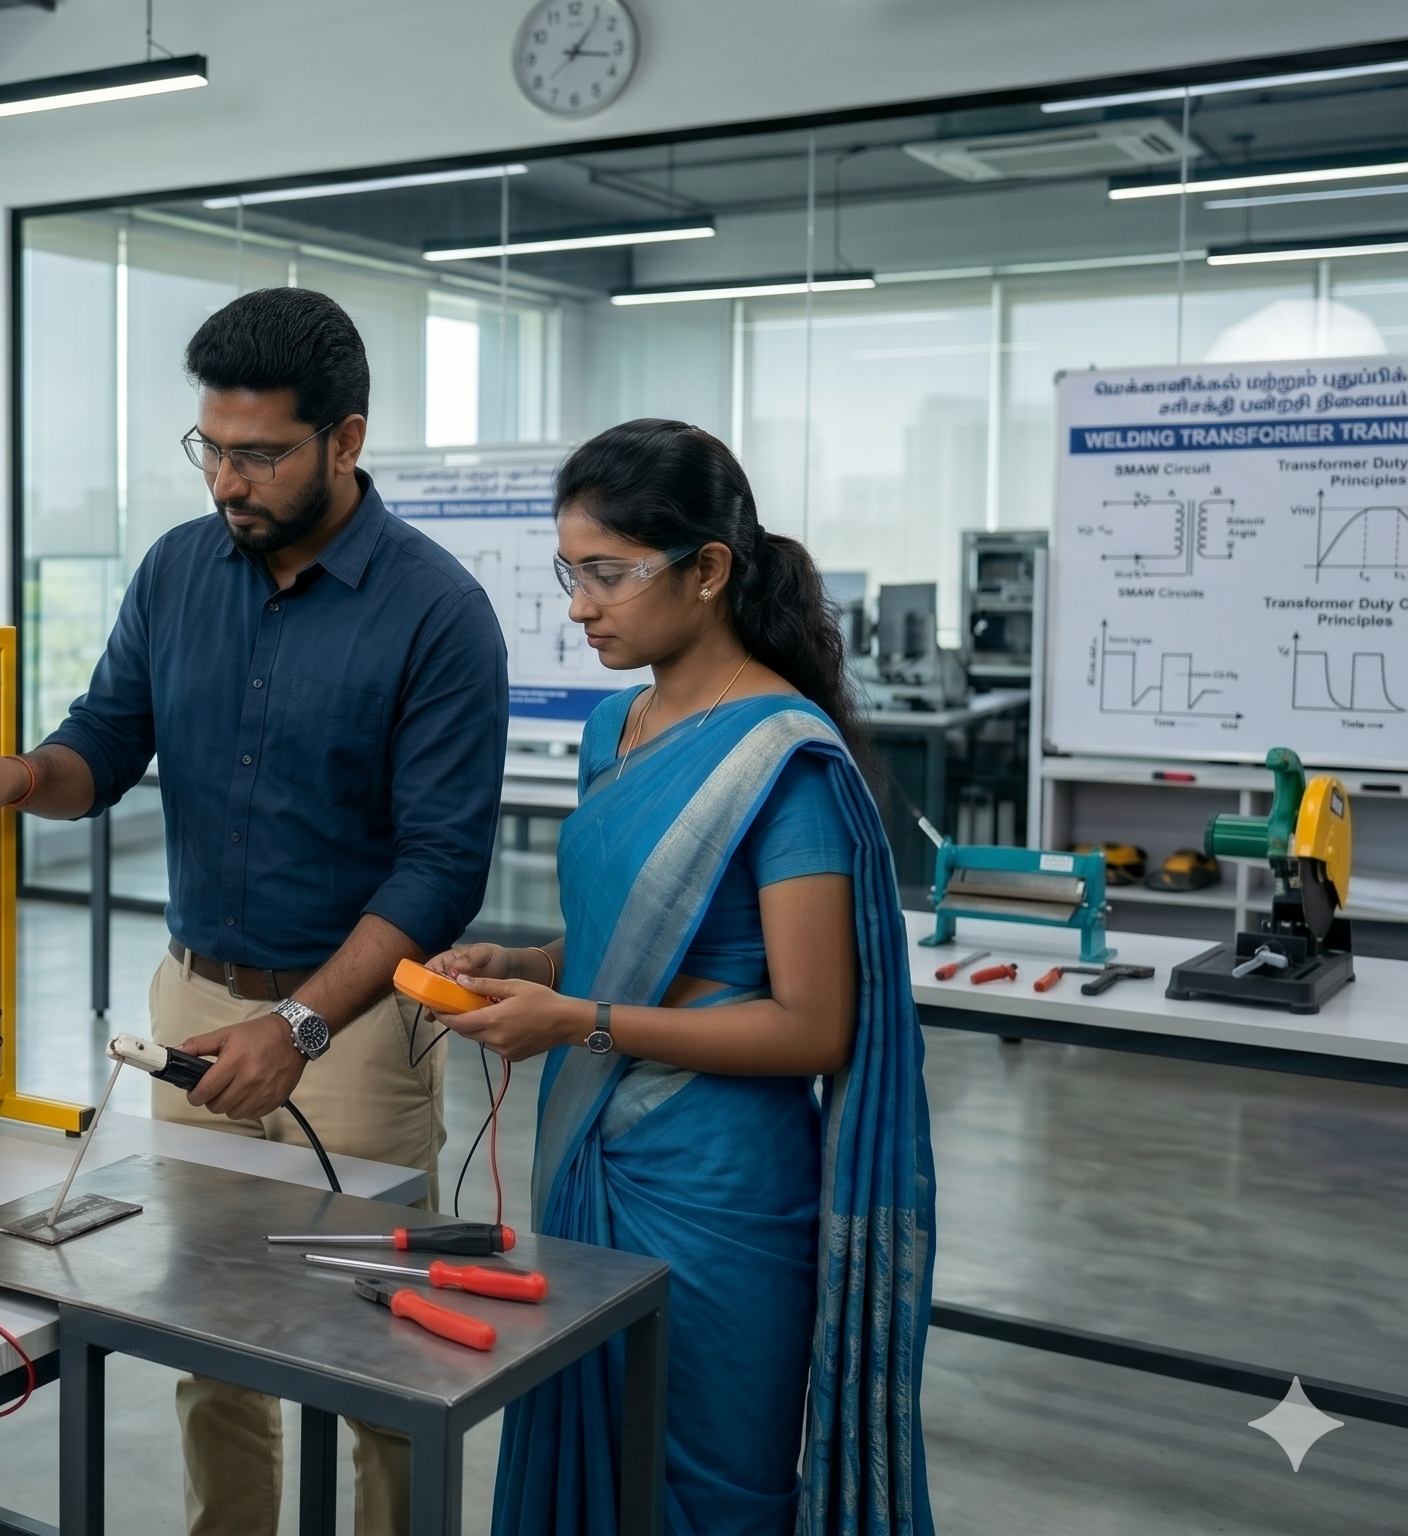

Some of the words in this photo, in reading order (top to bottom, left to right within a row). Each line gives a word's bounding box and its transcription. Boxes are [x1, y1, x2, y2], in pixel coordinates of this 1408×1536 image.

[547, 10, 561, 25] 11
[607, 16, 618, 32] 2
[613, 40, 625, 56] 3
[1085, 429, 1176, 448] WELDING
[1180, 423, 1335, 447] TRANSFORMER
[1115, 463, 1159, 477] SMAW
[1164, 462, 1211, 476] Circuit
[1277, 458, 1368, 471] Transformer
[1373, 456, 1408, 471] Duty
[1330, 474, 1407, 488] Principles
[1118, 587, 1156, 598] SMAW
[1264, 596, 1355, 610] Transformer
[1359, 597, 1394, 612] Duty
[1317, 614, 1393, 628] Principles
